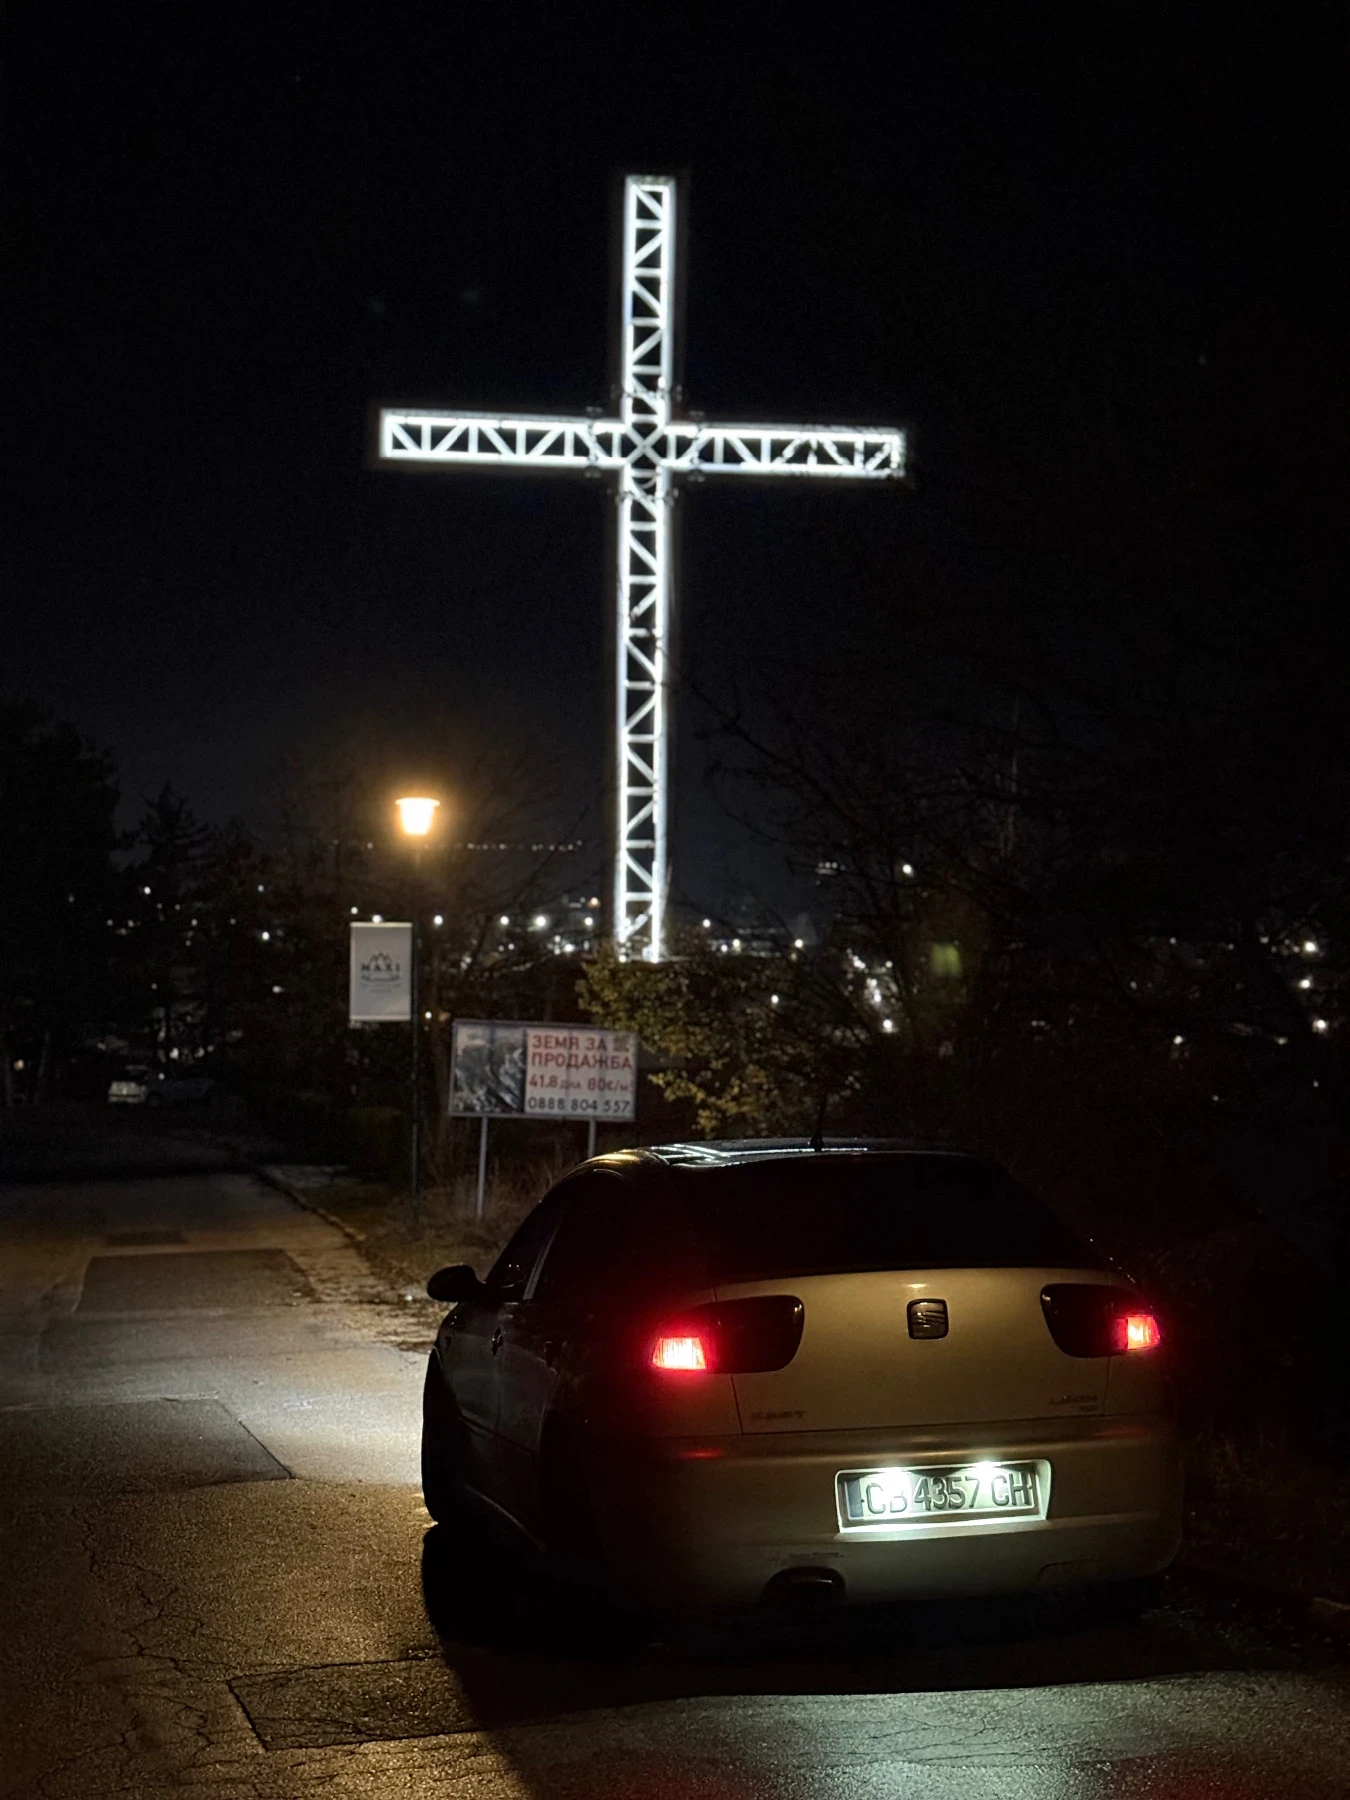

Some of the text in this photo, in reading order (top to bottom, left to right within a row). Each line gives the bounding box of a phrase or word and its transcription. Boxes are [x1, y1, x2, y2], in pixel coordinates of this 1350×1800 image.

[532, 1034, 607, 1050] ЗЕМЯ ЗА
[531, 1052, 632, 1070] ПРОДАЖБА
[528, 1096, 631, 1113] 0888 804 557
[914, 1476, 981, 1511] 4357
[991, 1472, 1031, 1506] CH
